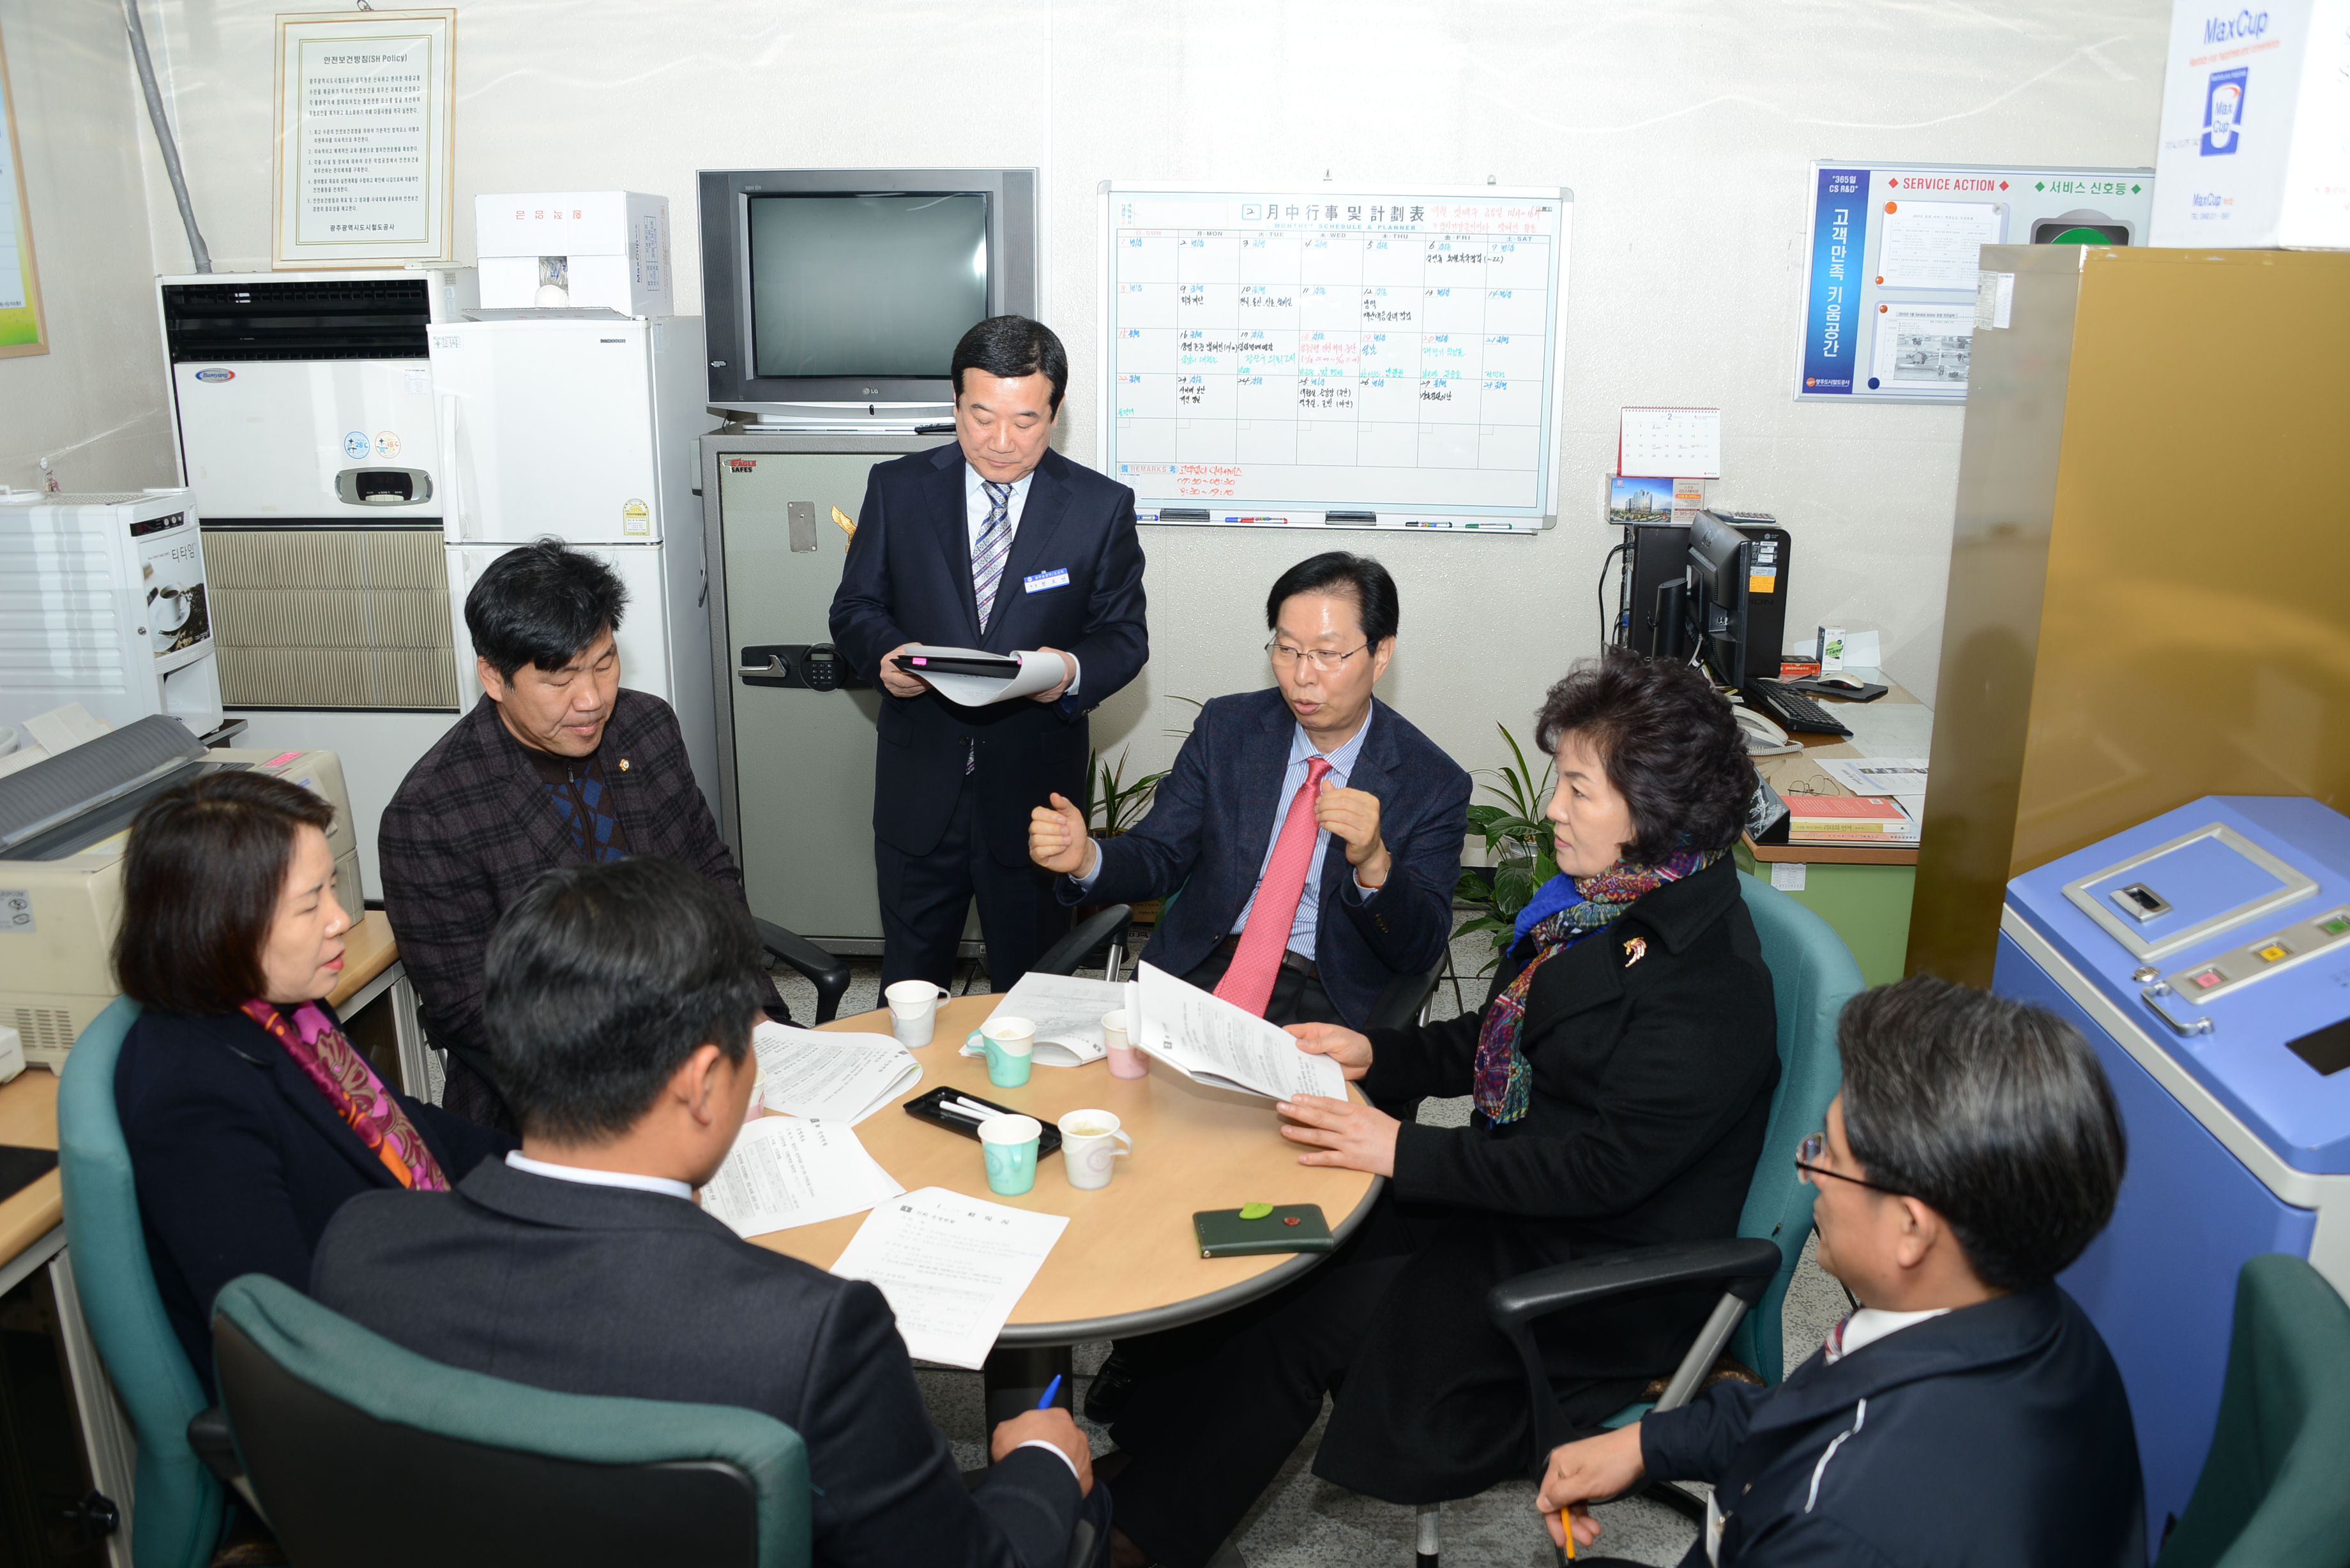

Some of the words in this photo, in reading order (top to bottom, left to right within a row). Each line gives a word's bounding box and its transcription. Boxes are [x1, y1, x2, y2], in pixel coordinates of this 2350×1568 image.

[324, 55, 381, 64] 안전보건방침(SH
[383, 54, 407, 63] Policy)
[1829, 185, 1839, 193] CS
[1903, 177, 1950, 191] SERVICE
[1953, 179, 1995, 192] ACTION
[2050, 181, 2086, 194] 서비스
[2089, 181, 2126, 195] 신호등
[1267, 204, 1338, 222] 月中行事
[1371, 206, 1425, 222] 計劃表
[330, 223, 395, 232] 광주광역시도시철도공사
[1828, 208, 1849, 281] 고객만족
[1823, 286, 1844, 359] 키움공간
[731, 458, 757, 467] EAGLE
[171, 543, 195, 563] 티타임
